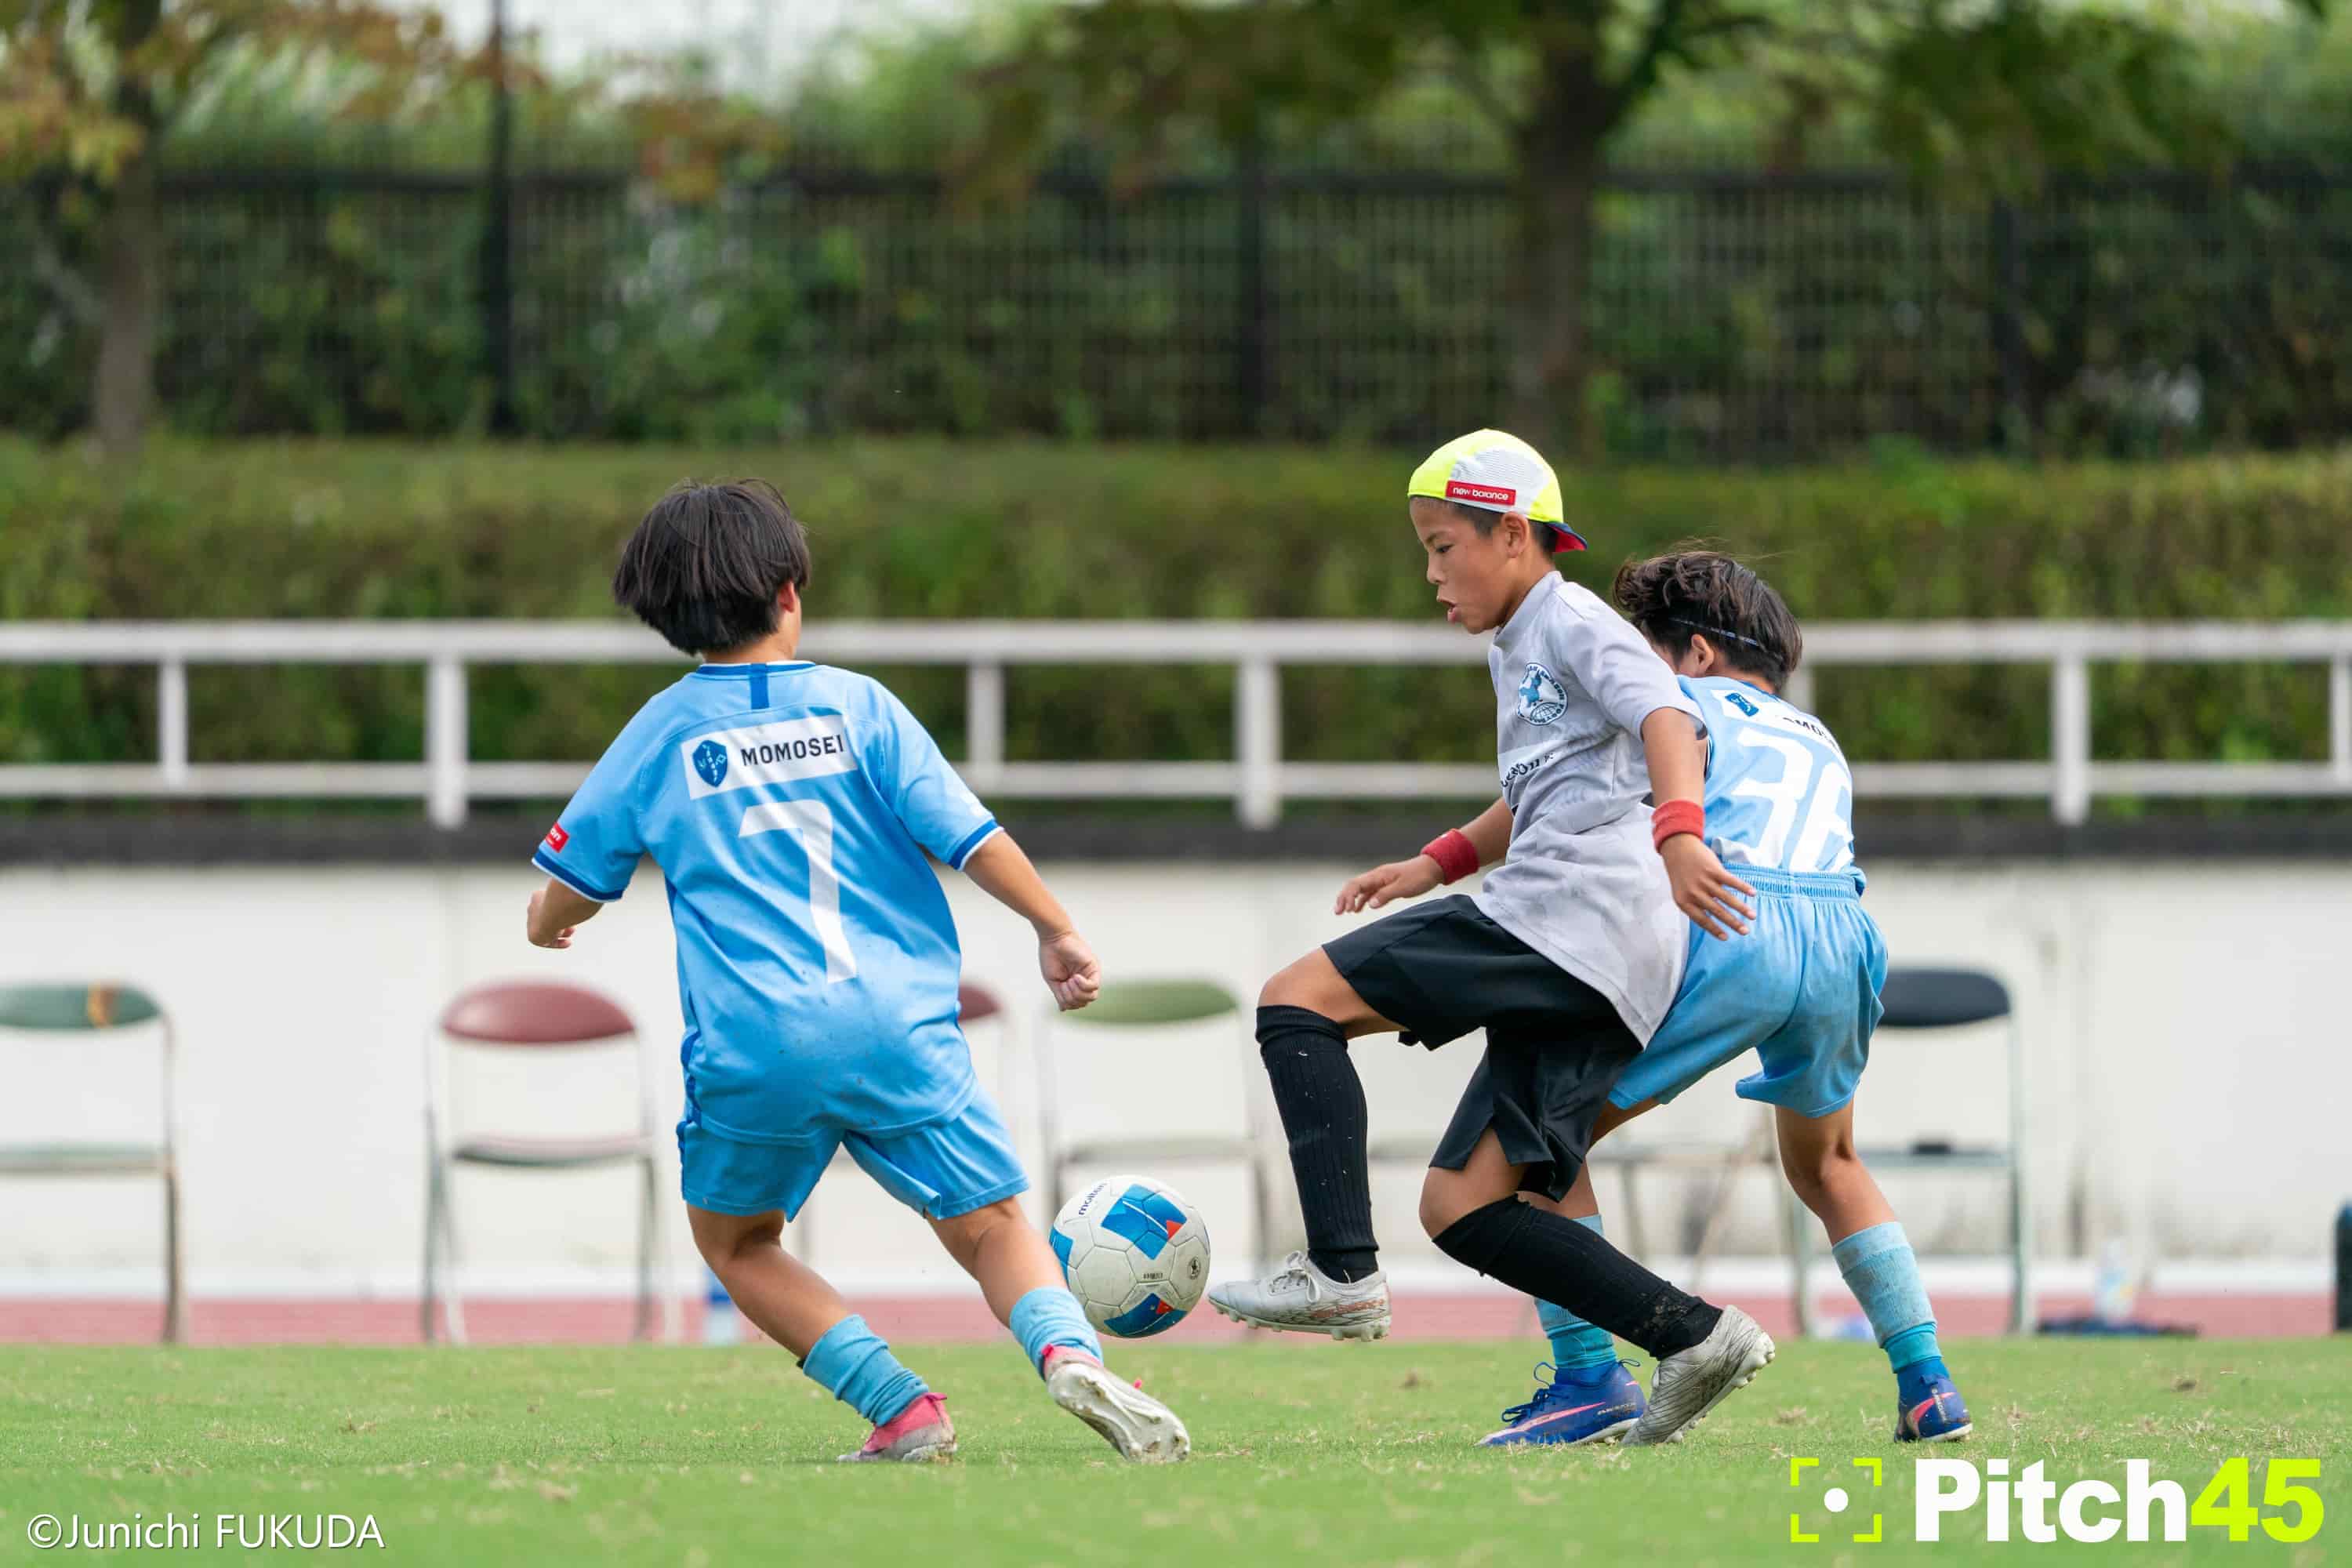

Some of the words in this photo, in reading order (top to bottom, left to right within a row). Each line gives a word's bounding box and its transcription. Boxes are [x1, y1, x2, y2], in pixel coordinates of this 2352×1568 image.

[1453, 487, 1470, 496] new
[1472, 488, 1509, 501] balance
[740, 734, 844, 767] MOMOSEI
[1714, 727, 1854, 873] 36
[739, 799, 857, 984] 7
